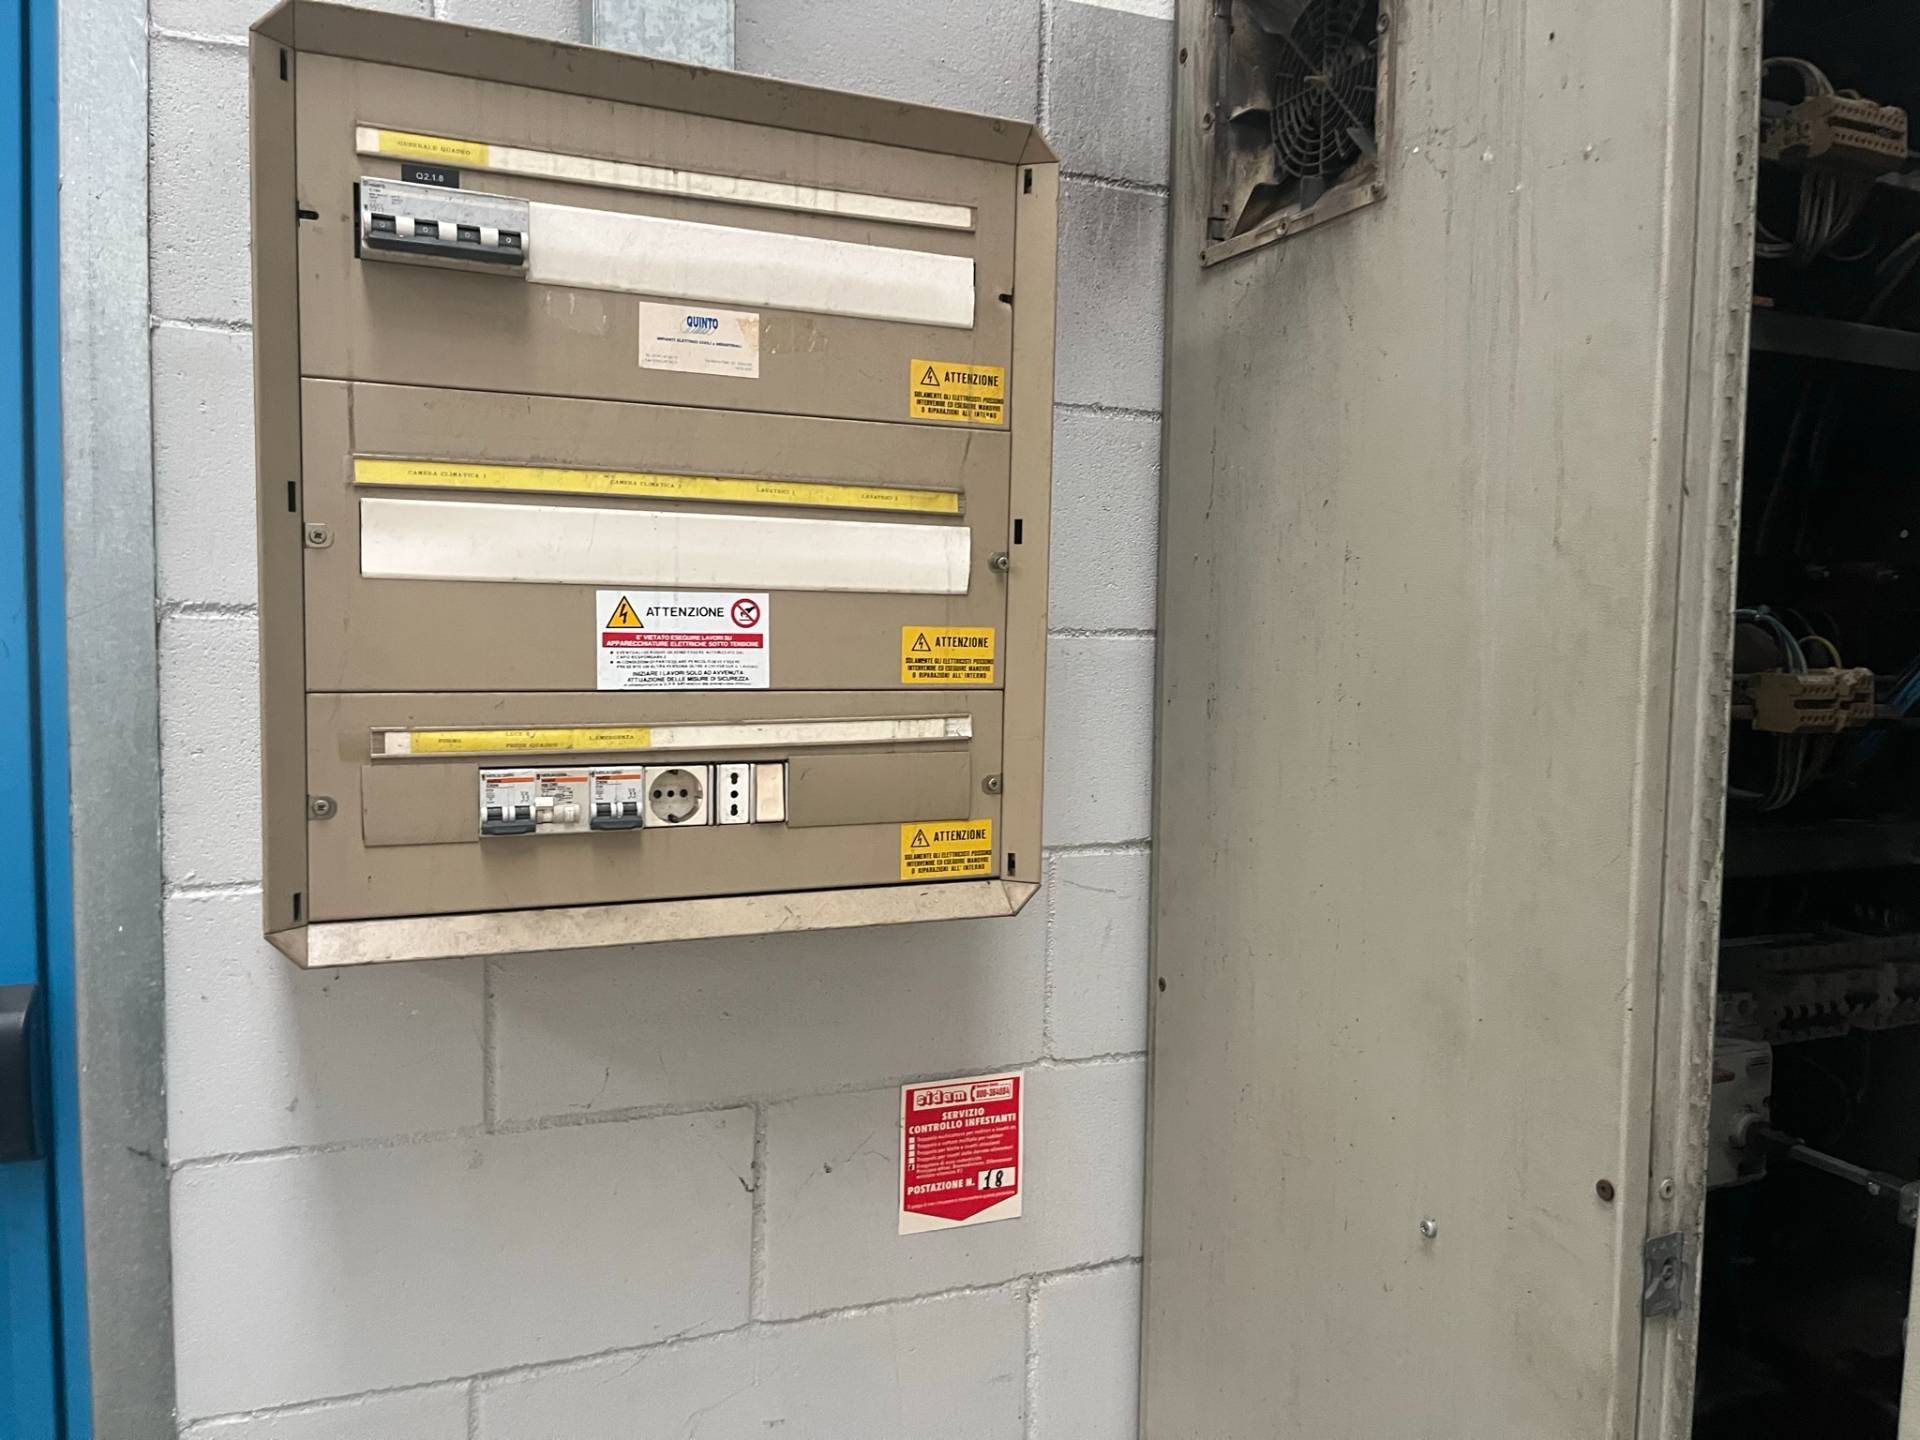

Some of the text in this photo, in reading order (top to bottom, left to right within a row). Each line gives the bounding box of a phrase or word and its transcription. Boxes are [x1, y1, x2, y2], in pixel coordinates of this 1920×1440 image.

[687, 316, 718, 329] QUINTO
[944, 372, 998, 386] ATTENZIONE
[975, 411, 997, 419] INTERNO
[646, 607, 724, 617] ATTENZIONE
[935, 637, 988, 647] ATTENZIONE
[934, 829, 986, 841] ATTENZIONE
[917, 1090, 967, 1106] sidam
[942, 1107, 984, 1121] SERVIZIO
[909, 1113, 1016, 1135] CONTROLLO INFESTANTI
[907, 1169, 1004, 1195] POSTAZIONE N. 18
